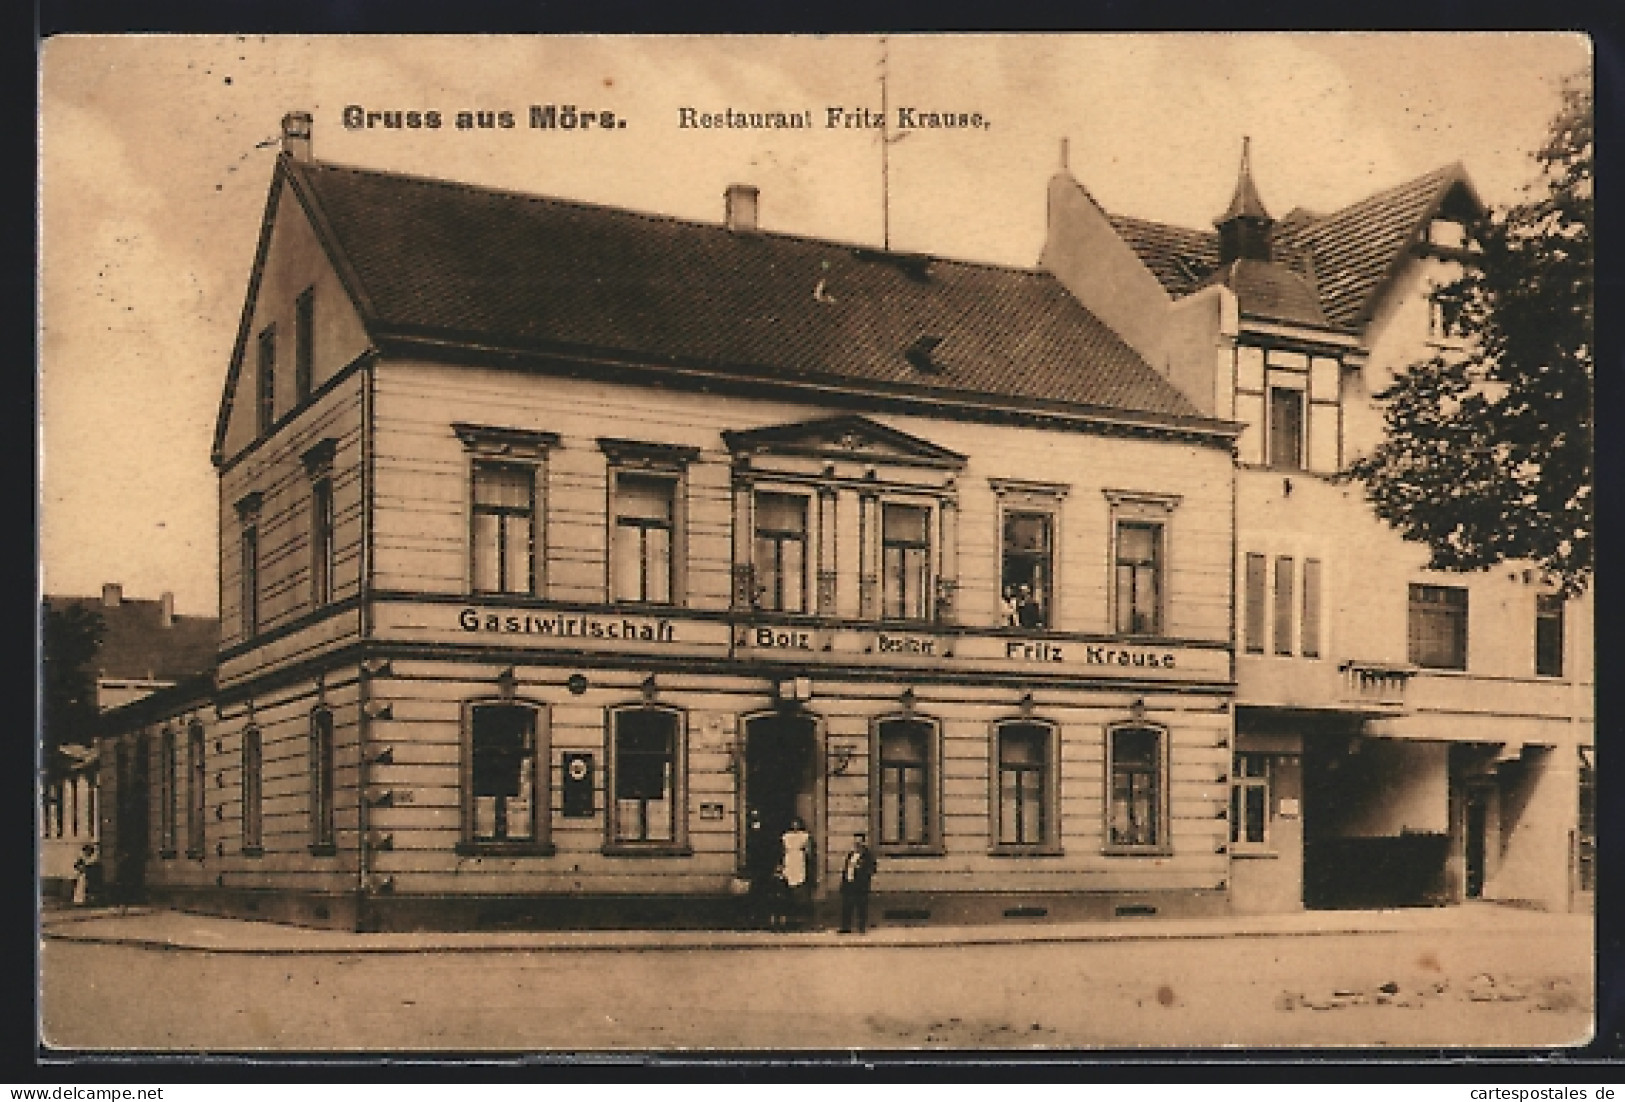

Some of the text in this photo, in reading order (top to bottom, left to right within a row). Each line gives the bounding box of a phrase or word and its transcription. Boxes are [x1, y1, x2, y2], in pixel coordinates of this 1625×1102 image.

[459, 608, 676, 642] Gastwirtschaft
[1006, 642, 1063, 661] Fritz
[1086, 645, 1177, 669] Krause
